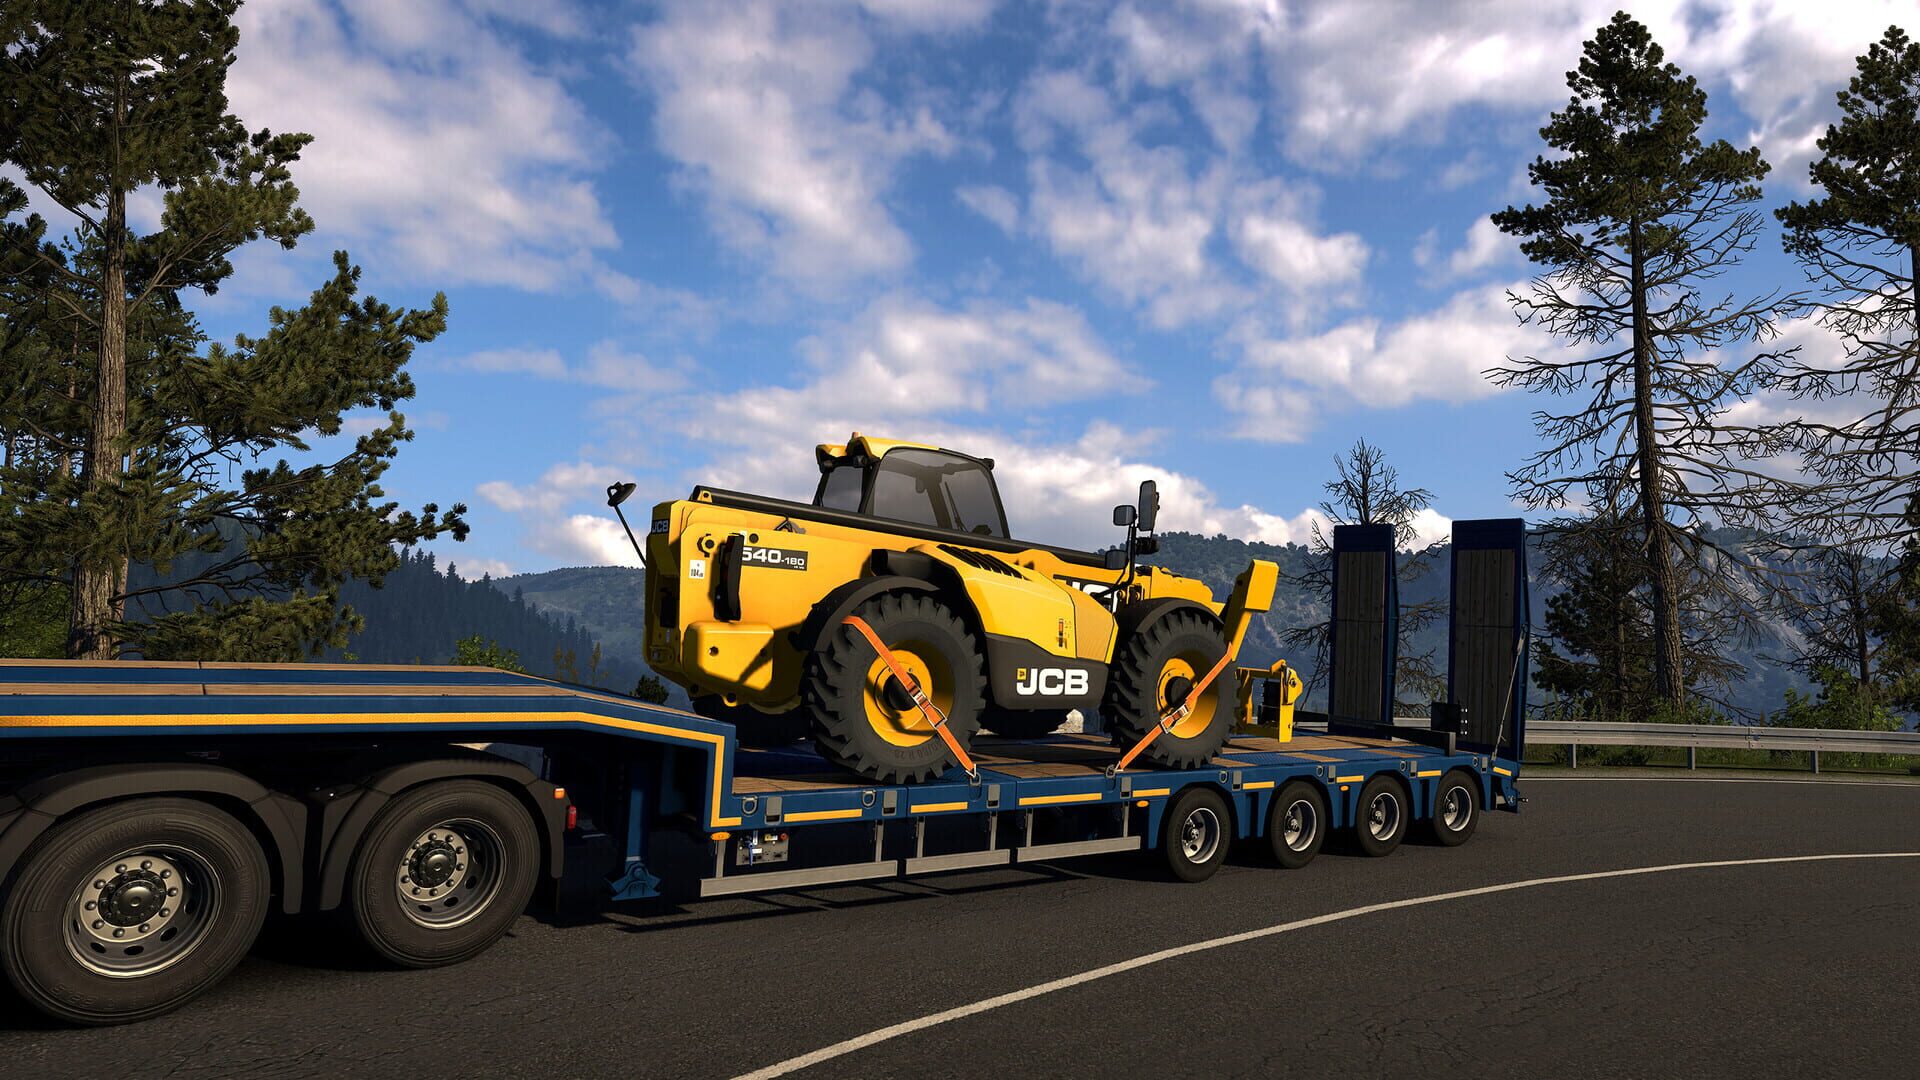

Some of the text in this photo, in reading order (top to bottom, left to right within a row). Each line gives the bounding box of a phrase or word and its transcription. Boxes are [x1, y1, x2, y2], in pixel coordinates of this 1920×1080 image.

[651, 520, 669, 533] JCB
[742, 546, 805, 566] 540-180
[1016, 668, 1089, 695] JCB
